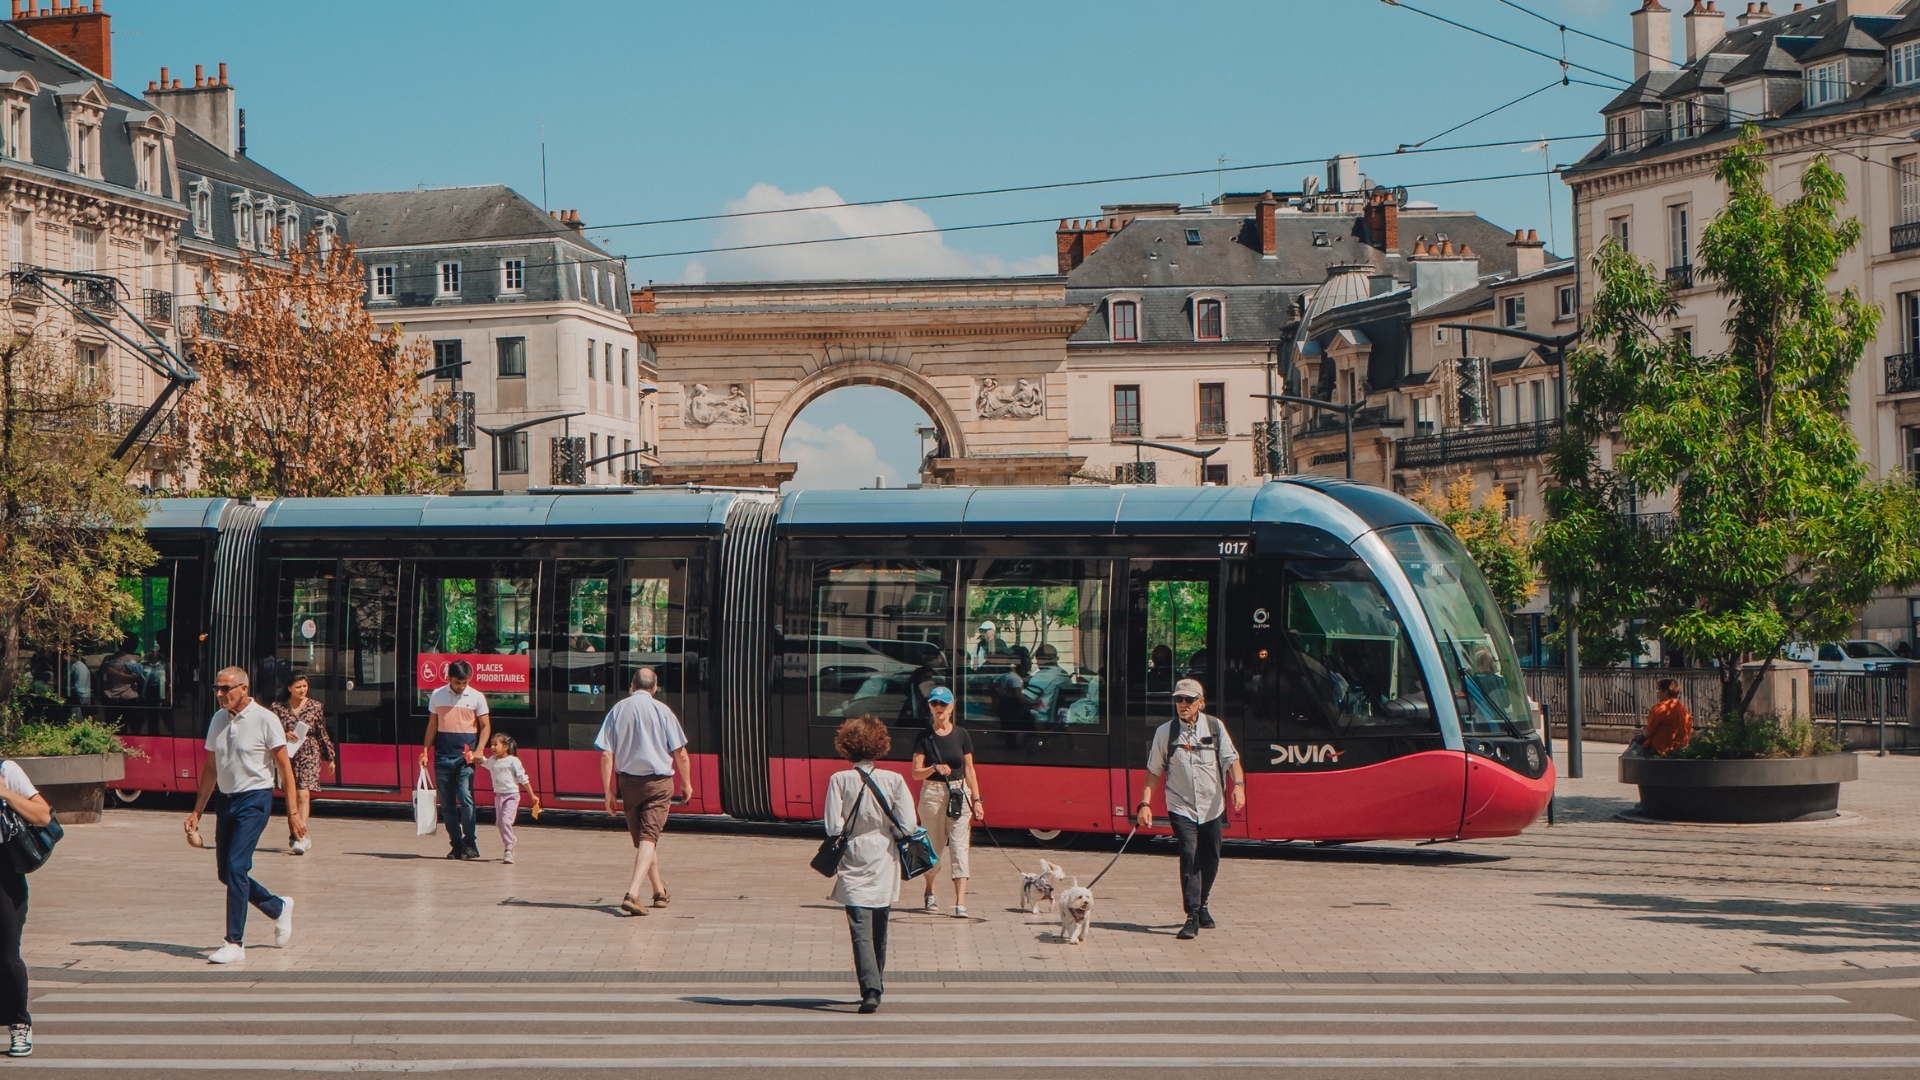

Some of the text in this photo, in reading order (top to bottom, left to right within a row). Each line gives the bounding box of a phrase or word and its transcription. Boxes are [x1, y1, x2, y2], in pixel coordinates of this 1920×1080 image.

[1315, 452, 1351, 465] PARIBA
[1218, 542, 1248, 554] 1017
[476, 663, 504, 672] PLACES
[476, 673, 525, 683] PRIORITAIRES
[1270, 744, 1346, 765] DIVIA
